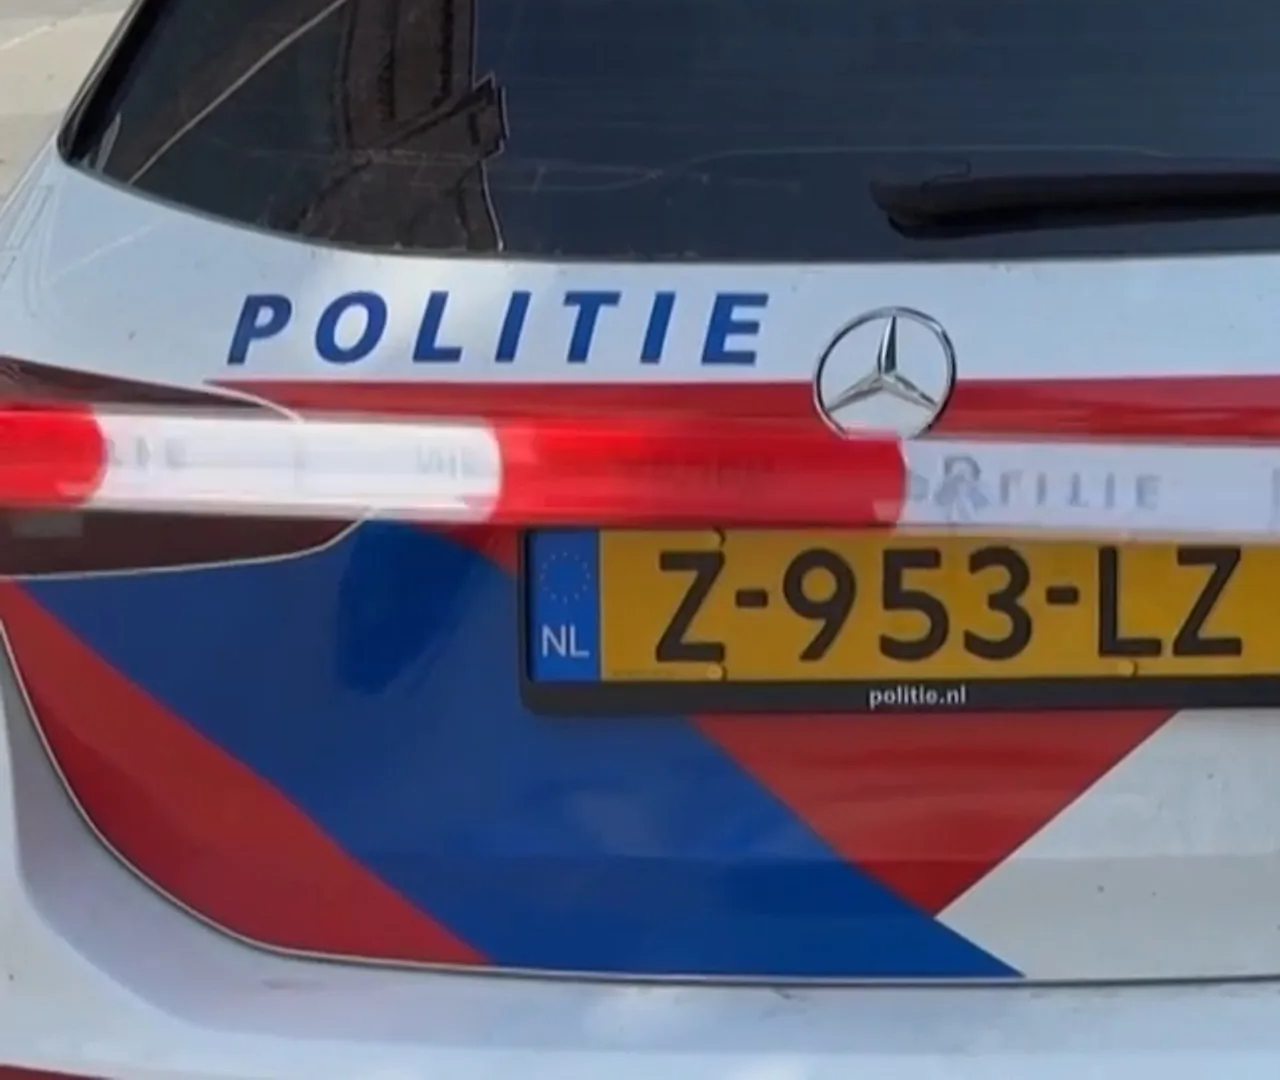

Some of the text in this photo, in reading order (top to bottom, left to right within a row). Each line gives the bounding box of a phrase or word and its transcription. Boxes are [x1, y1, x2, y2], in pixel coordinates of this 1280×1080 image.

[226, 290, 769, 365] POLITIE
[655, 546, 1243, 663] Z-953-LZ
[541, 624, 590, 658] NL
[869, 683, 967, 711] politie.nl
